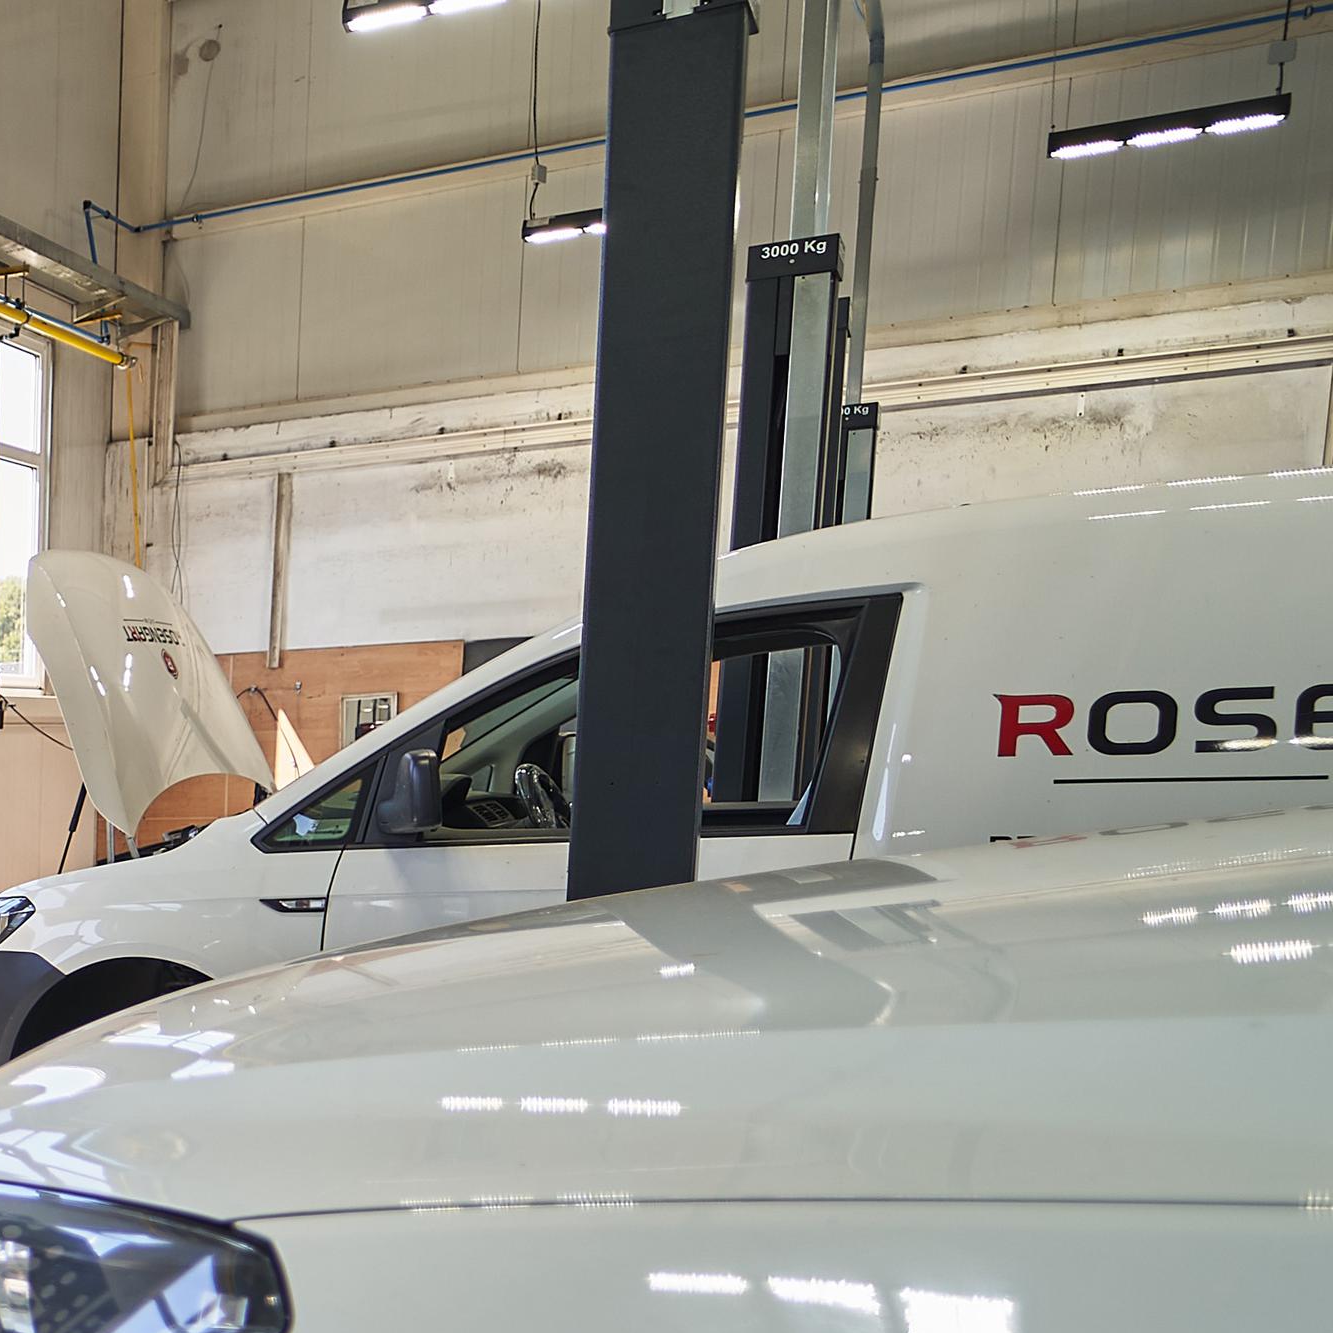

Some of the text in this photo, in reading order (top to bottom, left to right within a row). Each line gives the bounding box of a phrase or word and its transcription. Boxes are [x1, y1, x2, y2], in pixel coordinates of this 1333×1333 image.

[760, 240, 827, 259] 3000 Kg
[853, 405, 869, 416] Kg
